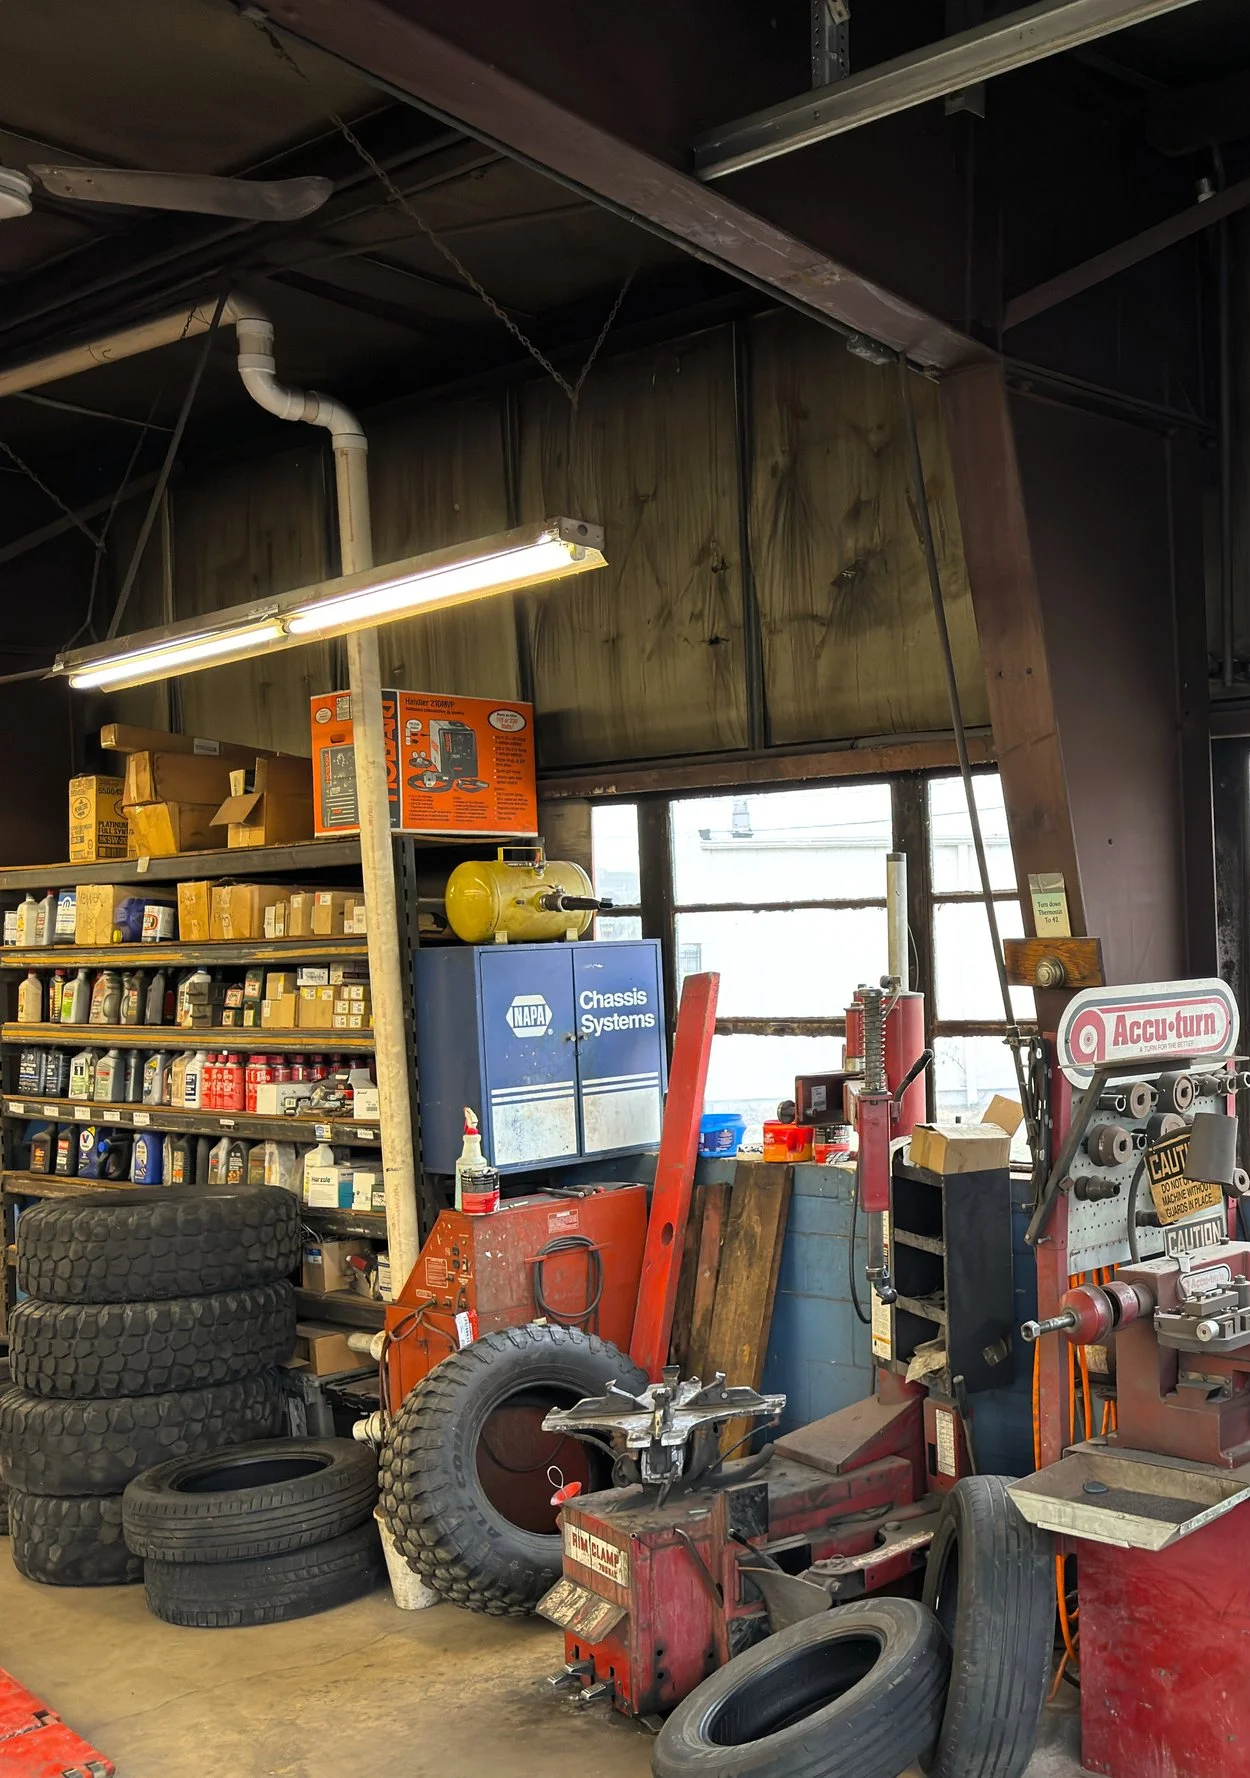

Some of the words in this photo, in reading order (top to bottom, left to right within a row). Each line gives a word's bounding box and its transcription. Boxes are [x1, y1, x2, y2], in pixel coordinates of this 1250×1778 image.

[579, 987, 648, 1010] Chassis
[513, 1005, 546, 1027] NAPA
[581, 1012, 655, 1037] Systems
[1177, 1039, 1194, 1048] BETTER
[1149, 1142, 1190, 1180] CAUT
[1161, 1182, 1170, 1193] DO
[1171, 1178, 1183, 1190] NOT
[1162, 1189, 1187, 1206] MACHINE
[1187, 1183, 1212, 1199] WITHOUT
[1165, 1202, 1188, 1218] GUARDS
[1188, 1200, 1194, 1210] IN
[1195, 1193, 1213, 1207] PLACE
[1168, 1220, 1221, 1254] CAUTION
[572, 1531, 588, 1553] RIM
[591, 1542, 620, 1568] CLAMP
